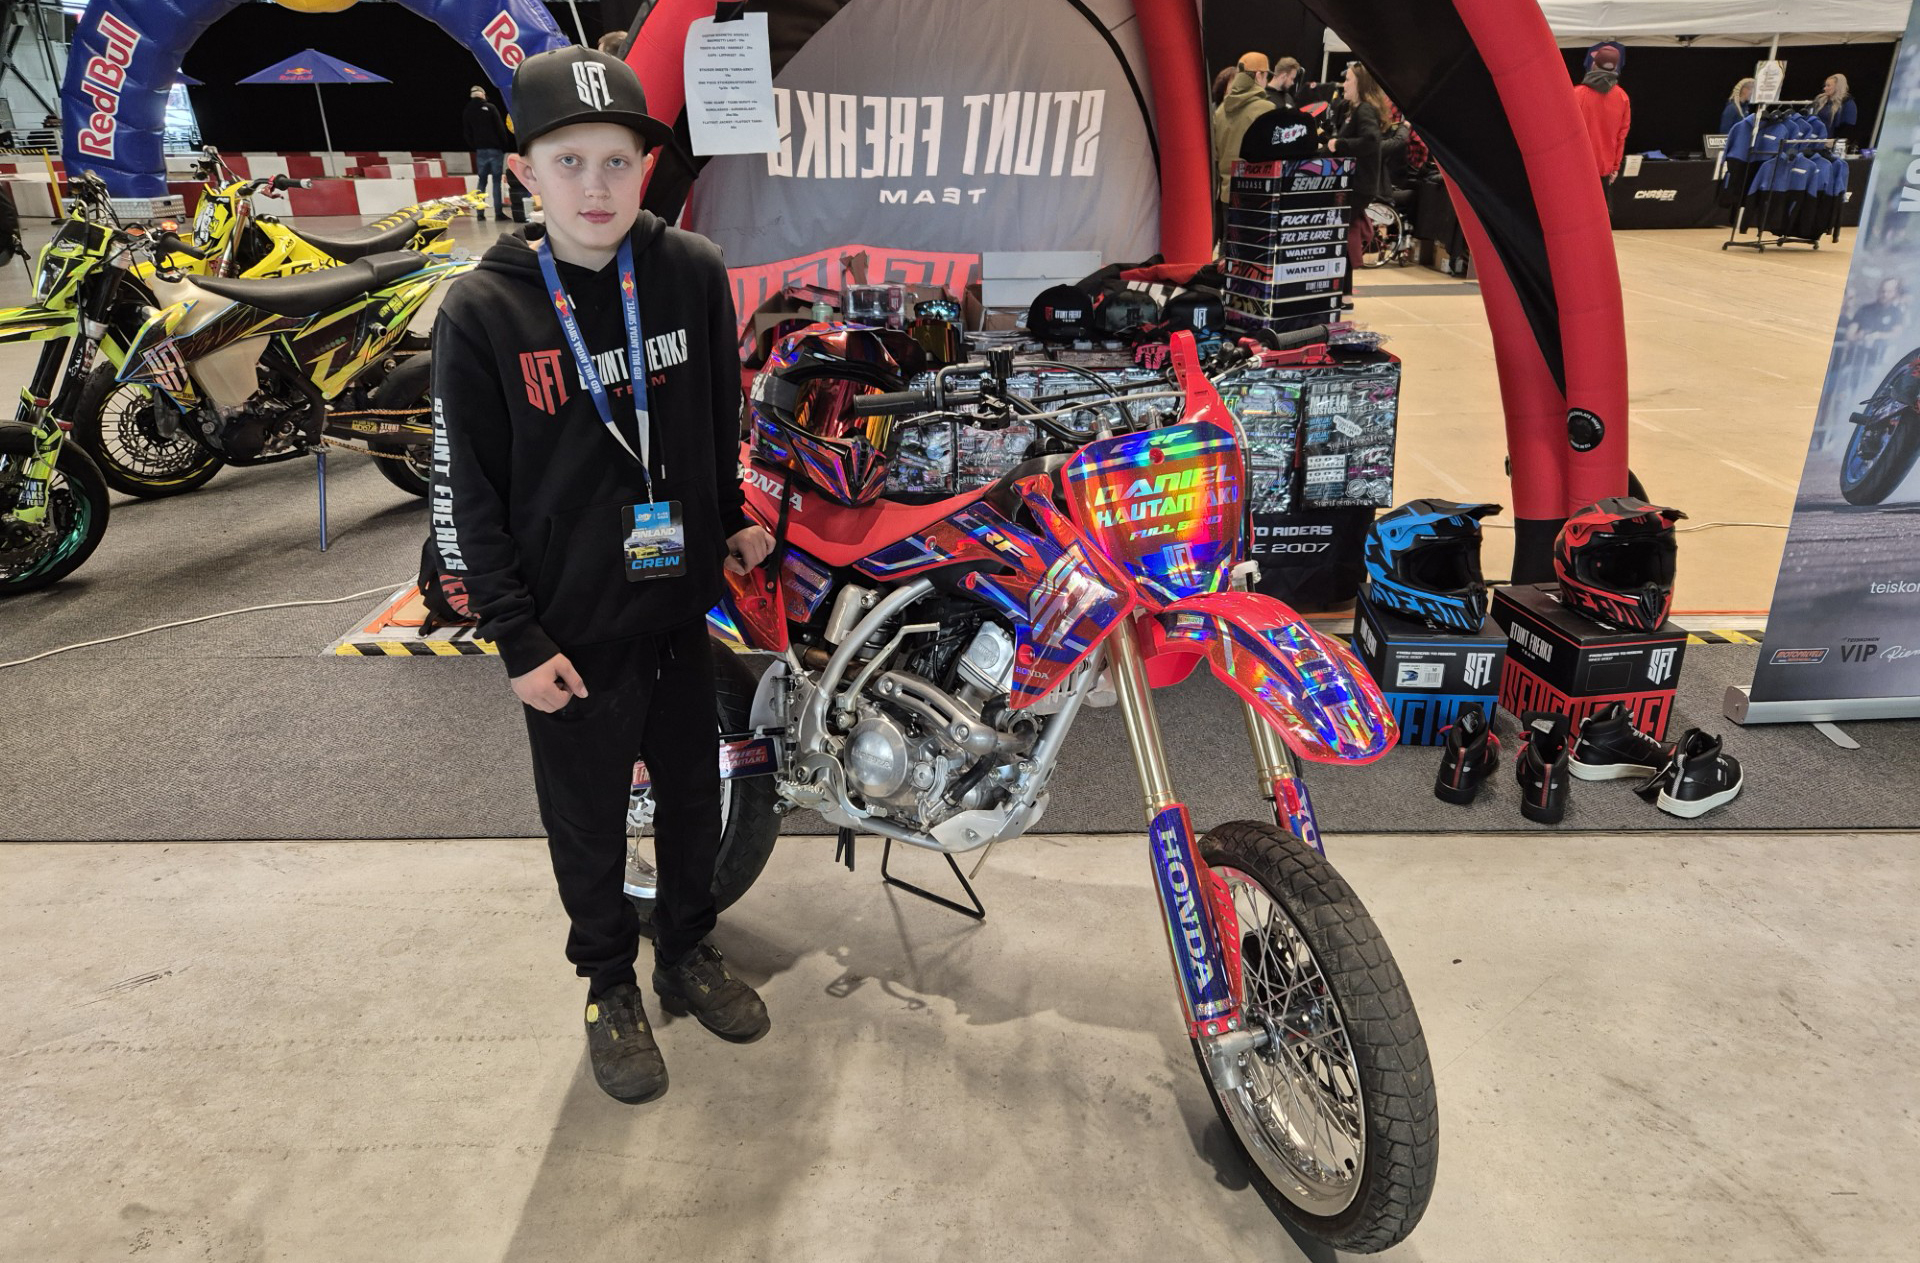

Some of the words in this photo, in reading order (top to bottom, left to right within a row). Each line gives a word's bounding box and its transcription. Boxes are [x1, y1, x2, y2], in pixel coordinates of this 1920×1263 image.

[481, 9, 526, 69] Re
[85, 11, 142, 93] Bull
[571, 61, 614, 111] SFT
[78, 80, 120, 160] Red
[1291, 176, 1321, 191] SEND
[1321, 176, 1336, 189] IT!
[1281, 215, 1308, 226] FUCK
[1310, 213, 1325, 224] IT!
[1285, 247, 1326, 257] WANTED
[1286, 265, 1325, 275] WANTED
[629, 326, 640, 349] ANTAA
[573, 341, 589, 365] ANTAA
[631, 349, 641, 366] BULL
[645, 328, 688, 372] EAKS
[519, 348, 571, 416] SFT
[583, 362, 598, 382] BULL
[633, 366, 642, 379] RED
[590, 379, 603, 394] RED
[613, 374, 666, 398] TEM
[1110, 429, 1193, 454] CRF
[24, 481, 44, 491] UNT
[1094, 464, 1237, 507] DANIEL
[433, 484, 468, 571] FREAKS
[631, 527, 676, 539] FINLAND
[1129, 524, 1175, 541] FULL
[1272, 526, 1333, 537] RIDERS
[1271, 543, 1331, 554] 2007
[631, 555, 680, 570] CREW
[1509, 621, 1529, 649] STUNT
[1529, 632, 1554, 663] FREAKS
[1841, 643, 1878, 663] VIP
[1015, 665, 1049, 679] HONDA
[1463, 652, 1496, 690] SFT
[1647, 647, 1678, 686] SFT
[1159, 825, 1214, 994] HONDA
